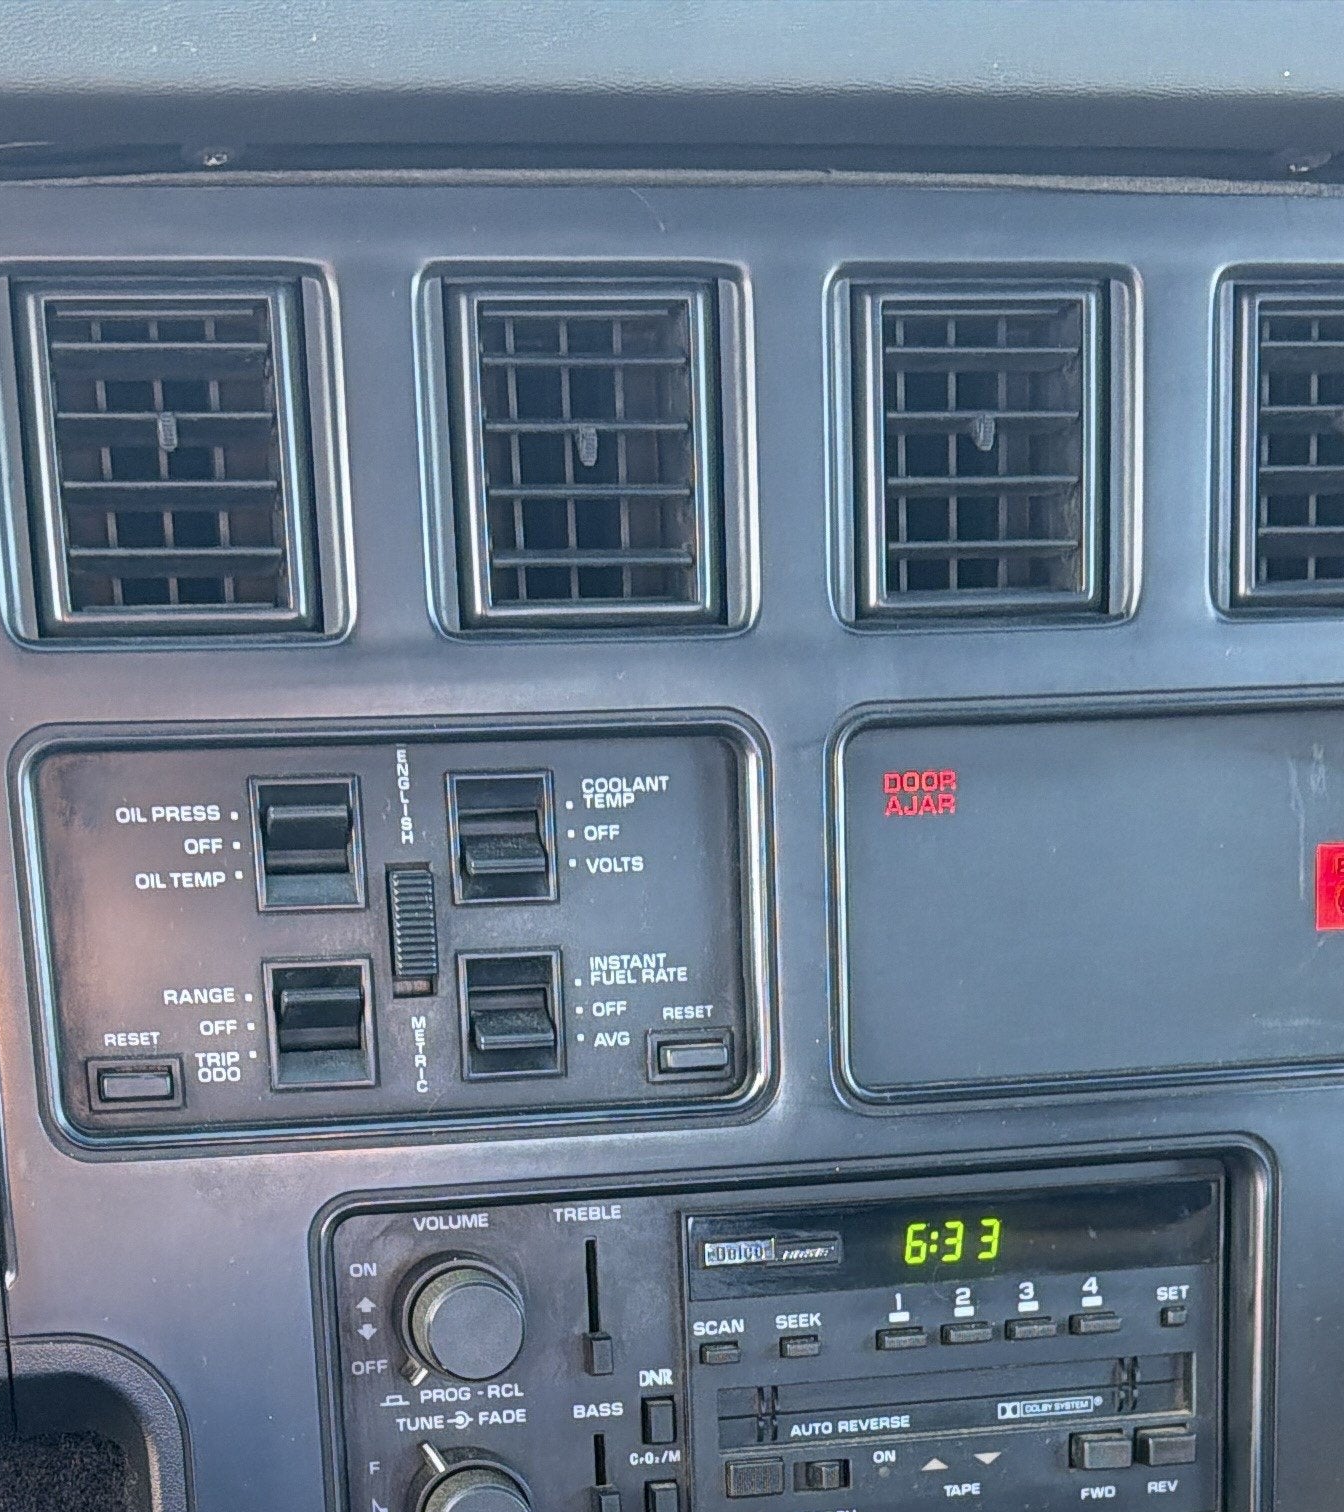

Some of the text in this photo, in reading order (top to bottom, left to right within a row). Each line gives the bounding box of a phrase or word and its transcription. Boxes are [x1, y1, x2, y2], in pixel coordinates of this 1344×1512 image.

[581, 775, 670, 793] COOLANT
[884, 770, 957, 794] DOOR
[396, 749, 414, 845] ENGLISH
[582, 792, 635, 809] TEMP
[884, 792, 956, 816] AJAR
[115, 804, 221, 824] OIL PRESS
[583, 824, 620, 841] OFF
[183, 837, 223, 855] OFF
[585, 855, 644, 874] VOLTS
[134, 871, 226, 890] OIL TEMP
[589, 952, 668, 971] INSTANT
[590, 964, 688, 987] FUEL RATE
[163, 987, 236, 1005] RANGE
[592, 1000, 628, 1017] OFF
[662, 1004, 714, 1021] RESET
[199, 1019, 238, 1036] OFF
[103, 1031, 161, 1047] RESET
[593, 1031, 631, 1048] AVG
[194, 1051, 240, 1070] TRIP
[411, 1015, 429, 1093] METRIC
[197, 1066, 241, 1083] ODO
[412, 1212, 489, 1232] VOLUME
[552, 1204, 622, 1223] TREBLE
[904, 1218, 1000, 1265] 6:33
[349, 1262, 378, 1278] ON
[1018, 1281, 1035, 1300] 3
[1082, 1276, 1099, 1295] 4
[1156, 1284, 1190, 1302] SET
[894, 1292, 902, 1311] 1
[955, 1287, 971, 1306] 2
[692, 1318, 745, 1336] SCAN
[775, 1312, 822, 1330] SEEK
[351, 1359, 388, 1376] OFF
[638, 1368, 674, 1388] DNR
[420, 1387, 472, 1404] PROG
[573, 1402, 624, 1419] BASS
[395, 1408, 527, 1432] TUNE FADE
[790, 1414, 911, 1438] AUTO REVERSE
[872, 1449, 896, 1464] ON
[369, 1460, 381, 1475] F
[943, 1482, 981, 1497] TAPE
[1080, 1485, 1116, 1500] FWD
[1147, 1479, 1179, 1494] REV
